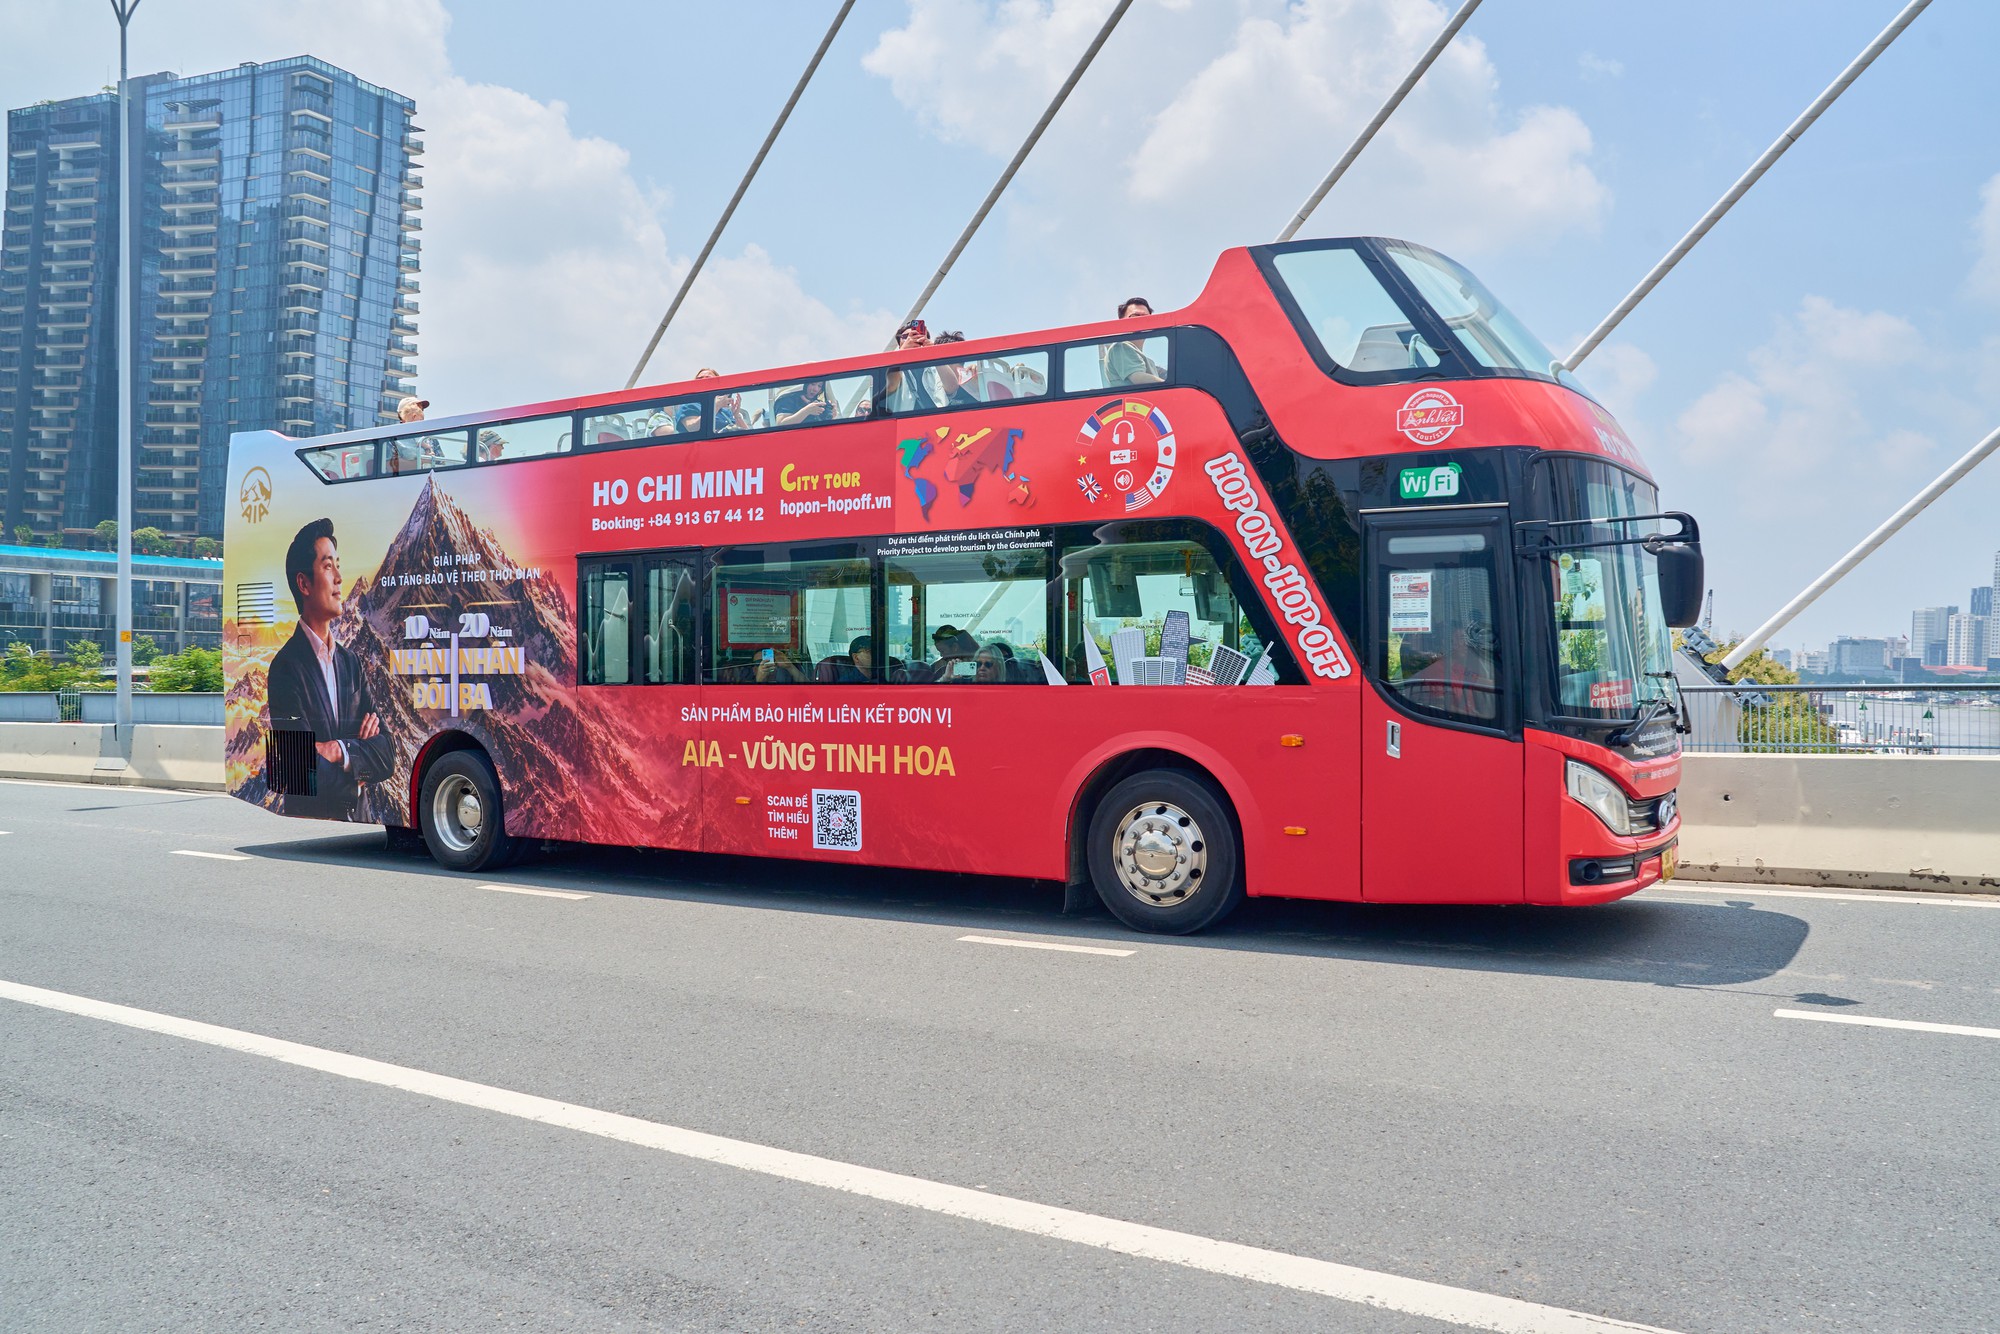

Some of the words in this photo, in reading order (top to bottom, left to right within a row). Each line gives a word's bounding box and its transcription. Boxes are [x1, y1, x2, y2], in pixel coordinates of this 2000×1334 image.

[1416, 431, 1444, 440] tourist
[593, 479, 628, 506] HO
[637, 474, 682, 503] CHI
[692, 468, 764, 498] MINH
[242, 503, 269, 523] AIA
[780, 493, 892, 517] hopon-hopoff.vn
[592, 516, 644, 531] Booking:
[648, 513, 671, 527] +84
[675, 512, 700, 525] 913
[704, 510, 720, 524] 67
[724, 509, 742, 522] 44
[747, 507, 764, 521] 12
[877, 548, 900, 556] Priority
[902, 547, 924, 555] Project
[933, 545, 959, 553] develop
[987, 543, 995, 551] by
[1010, 540, 1053, 549] Government
[888, 538, 898, 546] Dự
[935, 535, 950, 544] phát
[978, 532, 990, 541] lịch
[1004, 530, 1025, 538] Chính
[1026, 529, 1040, 539] phủ
[381, 576, 396, 587] GIA
[399, 572, 422, 586] TĂNG
[446, 570, 459, 585] VỆ
[462, 570, 486, 582] THEO
[490, 567, 512, 581] THỜI
[516, 568, 540, 580] GIAN
[404, 615, 429, 639] 10
[429, 628, 450, 639] Năm
[458, 613, 490, 638] 20
[490, 626, 512, 637] Năm
[390, 643, 450, 674] NHÂN
[459, 641, 524, 674] NHÂN
[414, 677, 450, 709] ĐÔI
[459, 683, 493, 709] BA
[681, 703, 708, 722] SẢN
[712, 702, 751, 722] PHẨM
[755, 704, 784, 722] BẢO
[788, 702, 823, 723] HIỂM
[828, 704, 860, 723] LIÊN
[866, 703, 894, 723] KẾT
[898, 707, 931, 724] ĐƠN
[936, 708, 951, 728] VỊ
[682, 740, 724, 767] AIA
[742, 736, 816, 771] VỮNG
[821, 744, 886, 774] TINH
[894, 745, 956, 776] HOA
[767, 796, 793, 807] SCAN
[795, 794, 808, 808] ĐỂ
[767, 810, 784, 822] TÌM
[786, 810, 809, 824] HIỂU
[768, 826, 798, 839] THÊM!
